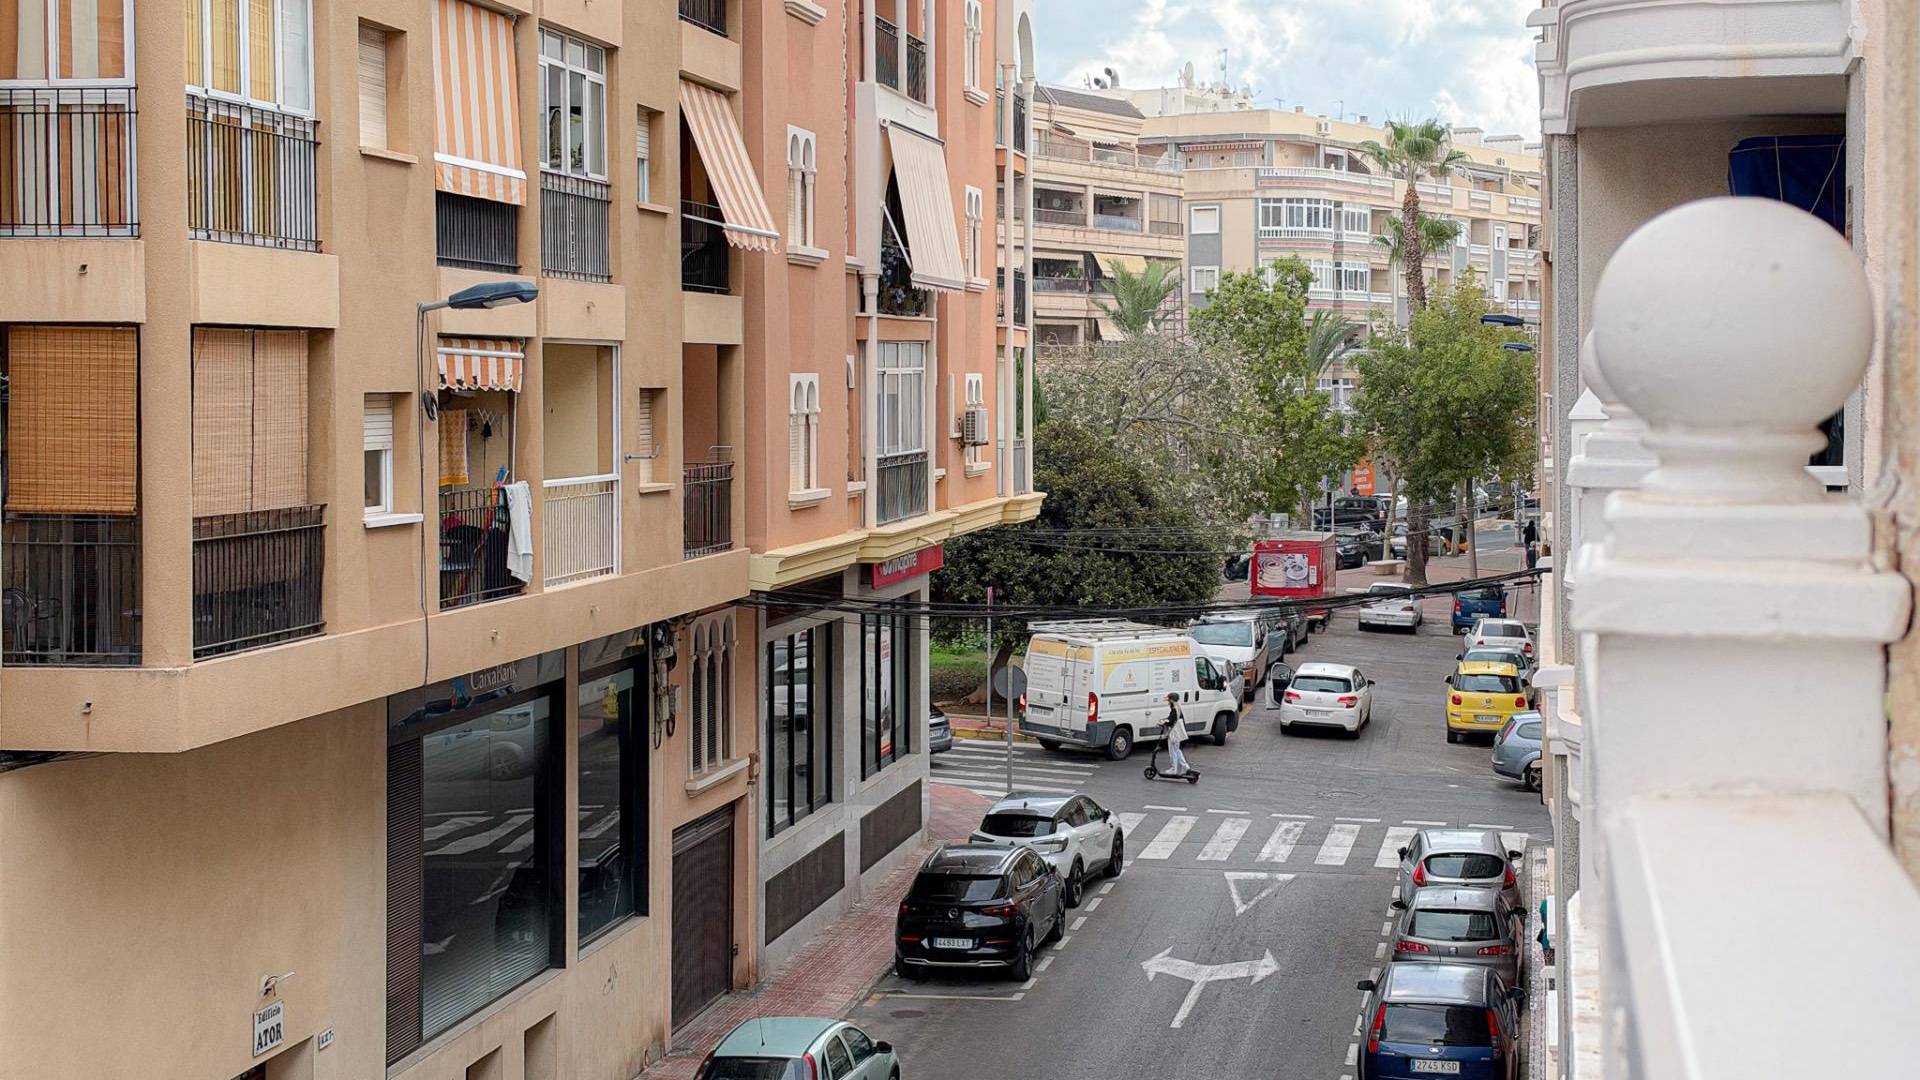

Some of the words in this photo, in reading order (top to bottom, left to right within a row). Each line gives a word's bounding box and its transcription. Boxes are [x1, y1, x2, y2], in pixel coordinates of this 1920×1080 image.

[470, 662, 519, 690] CaixaBank
[257, 1005, 281, 1024] Edificio
[256, 1022, 282, 1051] ATOR
[1416, 1060, 1439, 1071] 2745
[1440, 1062, 1458, 1072] KSD
